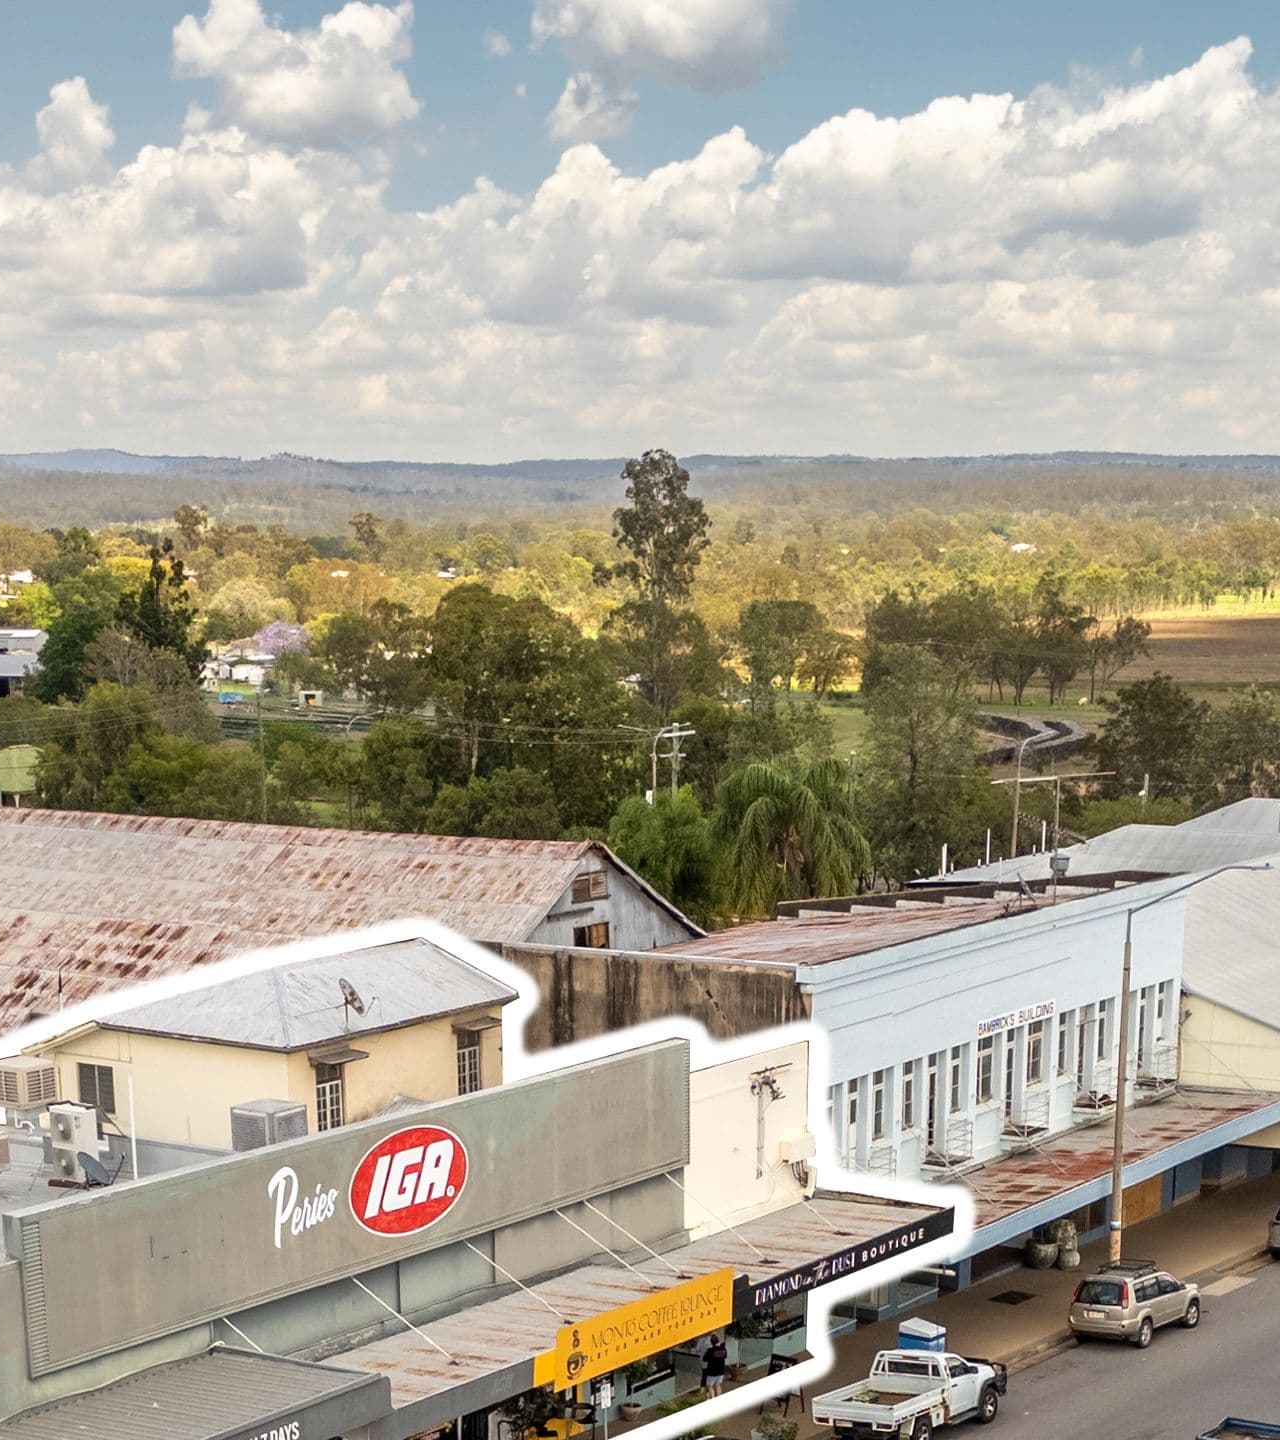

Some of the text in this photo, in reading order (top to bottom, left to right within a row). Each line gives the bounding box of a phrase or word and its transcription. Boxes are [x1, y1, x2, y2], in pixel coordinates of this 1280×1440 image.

[1018, 1001, 1055, 1023] BUILDING
[268, 1138, 455, 1249] Peries IGA
[755, 1273, 803, 1306] DIAMOND
[831, 1251, 856, 1276] DUST
[862, 1227, 926, 1263] BOUTIQUE
[589, 1306, 718, 1363] LET US MAKE YOUR DAY
[638, 1304, 679, 1335] COFFEE
[680, 1284, 724, 1316] LOUNGE
